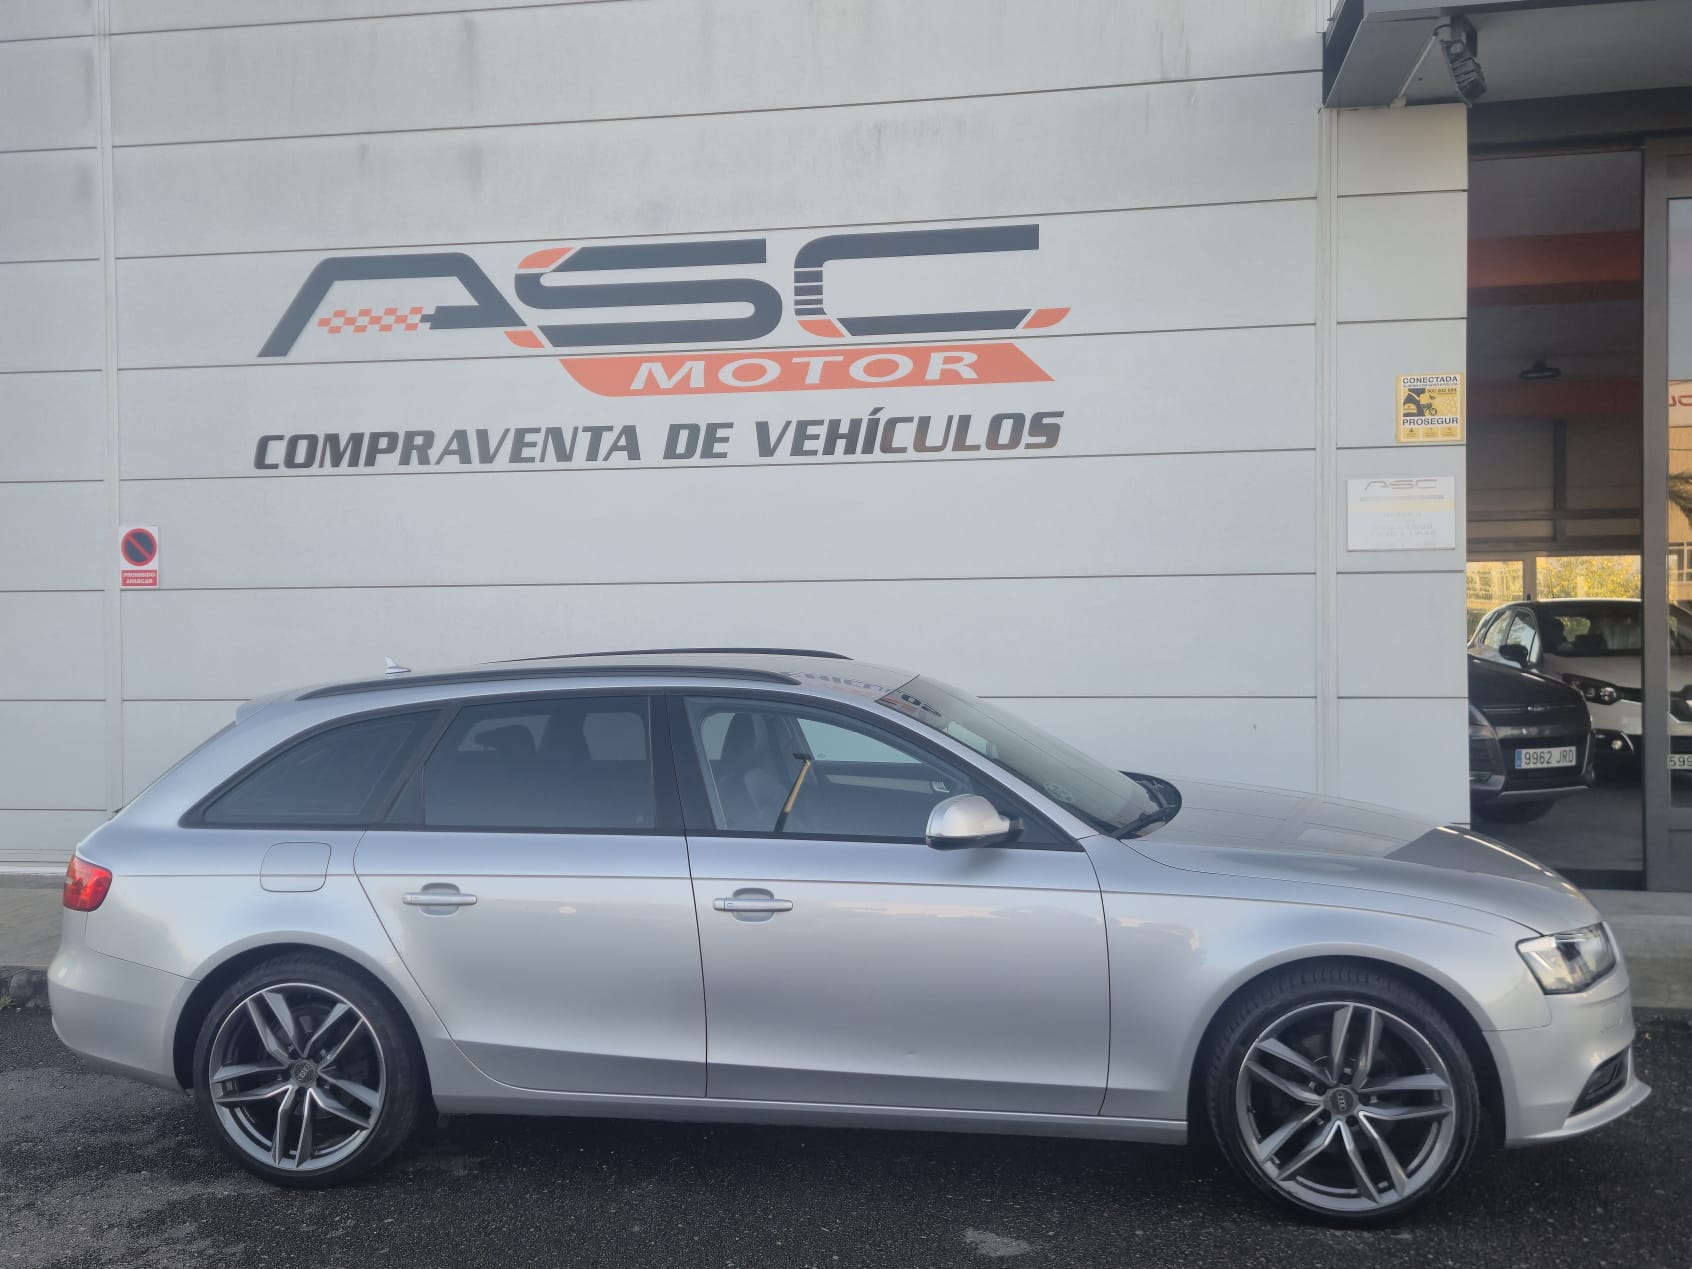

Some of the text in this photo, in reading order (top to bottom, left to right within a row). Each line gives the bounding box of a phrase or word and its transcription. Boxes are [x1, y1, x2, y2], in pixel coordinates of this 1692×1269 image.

[256, 223, 1071, 357] ASC
[629, 350, 980, 391] MOTOR
[1402, 376, 1458, 384] CONECTADA
[1402, 417, 1459, 426] PROSEGUR
[254, 406, 1065, 470] COMPRAVENTA DE VEHÍCULOS
[1524, 749, 1575, 765] 9962 JRD
